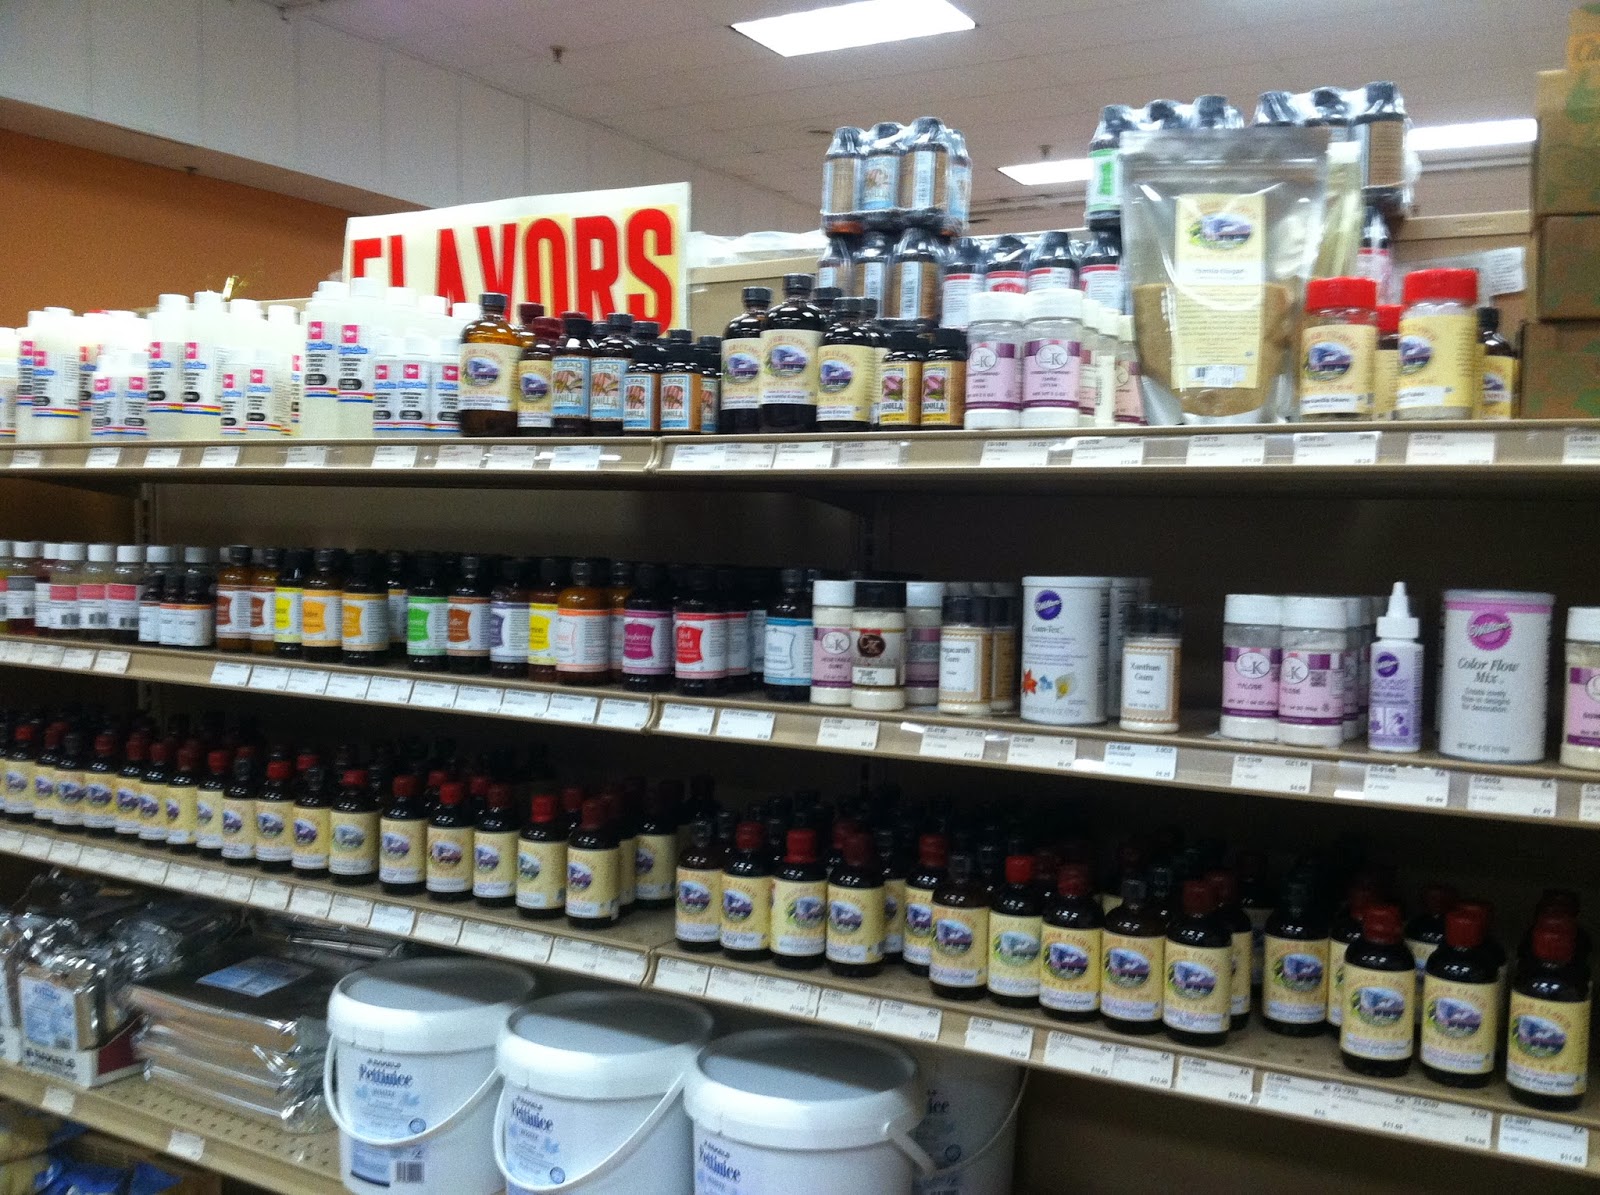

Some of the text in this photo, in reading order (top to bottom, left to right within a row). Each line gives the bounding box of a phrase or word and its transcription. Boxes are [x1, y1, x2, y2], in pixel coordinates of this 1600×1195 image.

[1458, 658, 1520, 672] Color Flow
[1474, 672, 1498, 683] Mix
